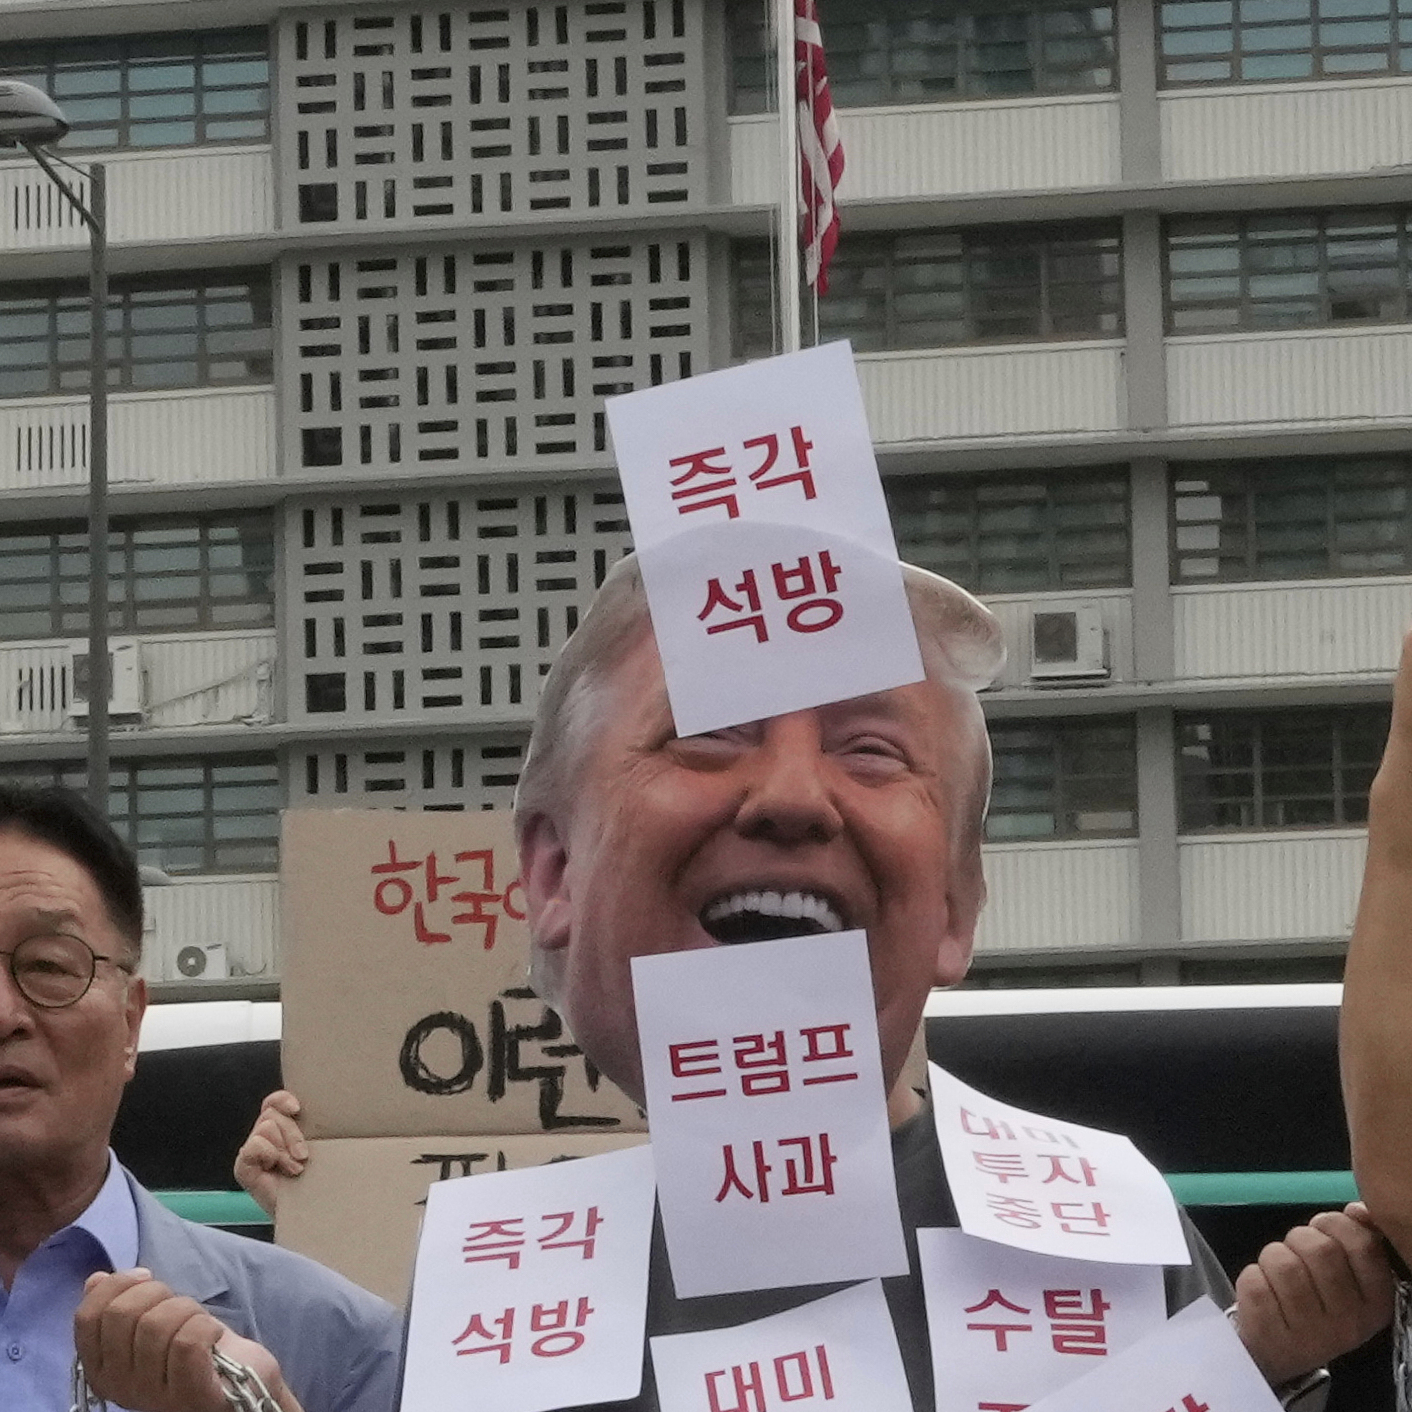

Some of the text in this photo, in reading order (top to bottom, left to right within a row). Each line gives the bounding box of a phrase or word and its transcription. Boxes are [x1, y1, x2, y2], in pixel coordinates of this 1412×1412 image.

[670, 426, 817, 518] 즉각
[699, 551, 843, 642] 석방
[670, 1024, 858, 1101] 트럼프
[960, 1106, 1079, 1149] 대미
[717, 1134, 836, 1202] 사과
[972, 1151, 1098, 1189] 투자
[464, 1208, 602, 1269] 즉각
[985, 1192, 1111, 1237] 중단
[454, 1298, 593, 1363] 석방
[967, 1290, 1110, 1356] 수탈
